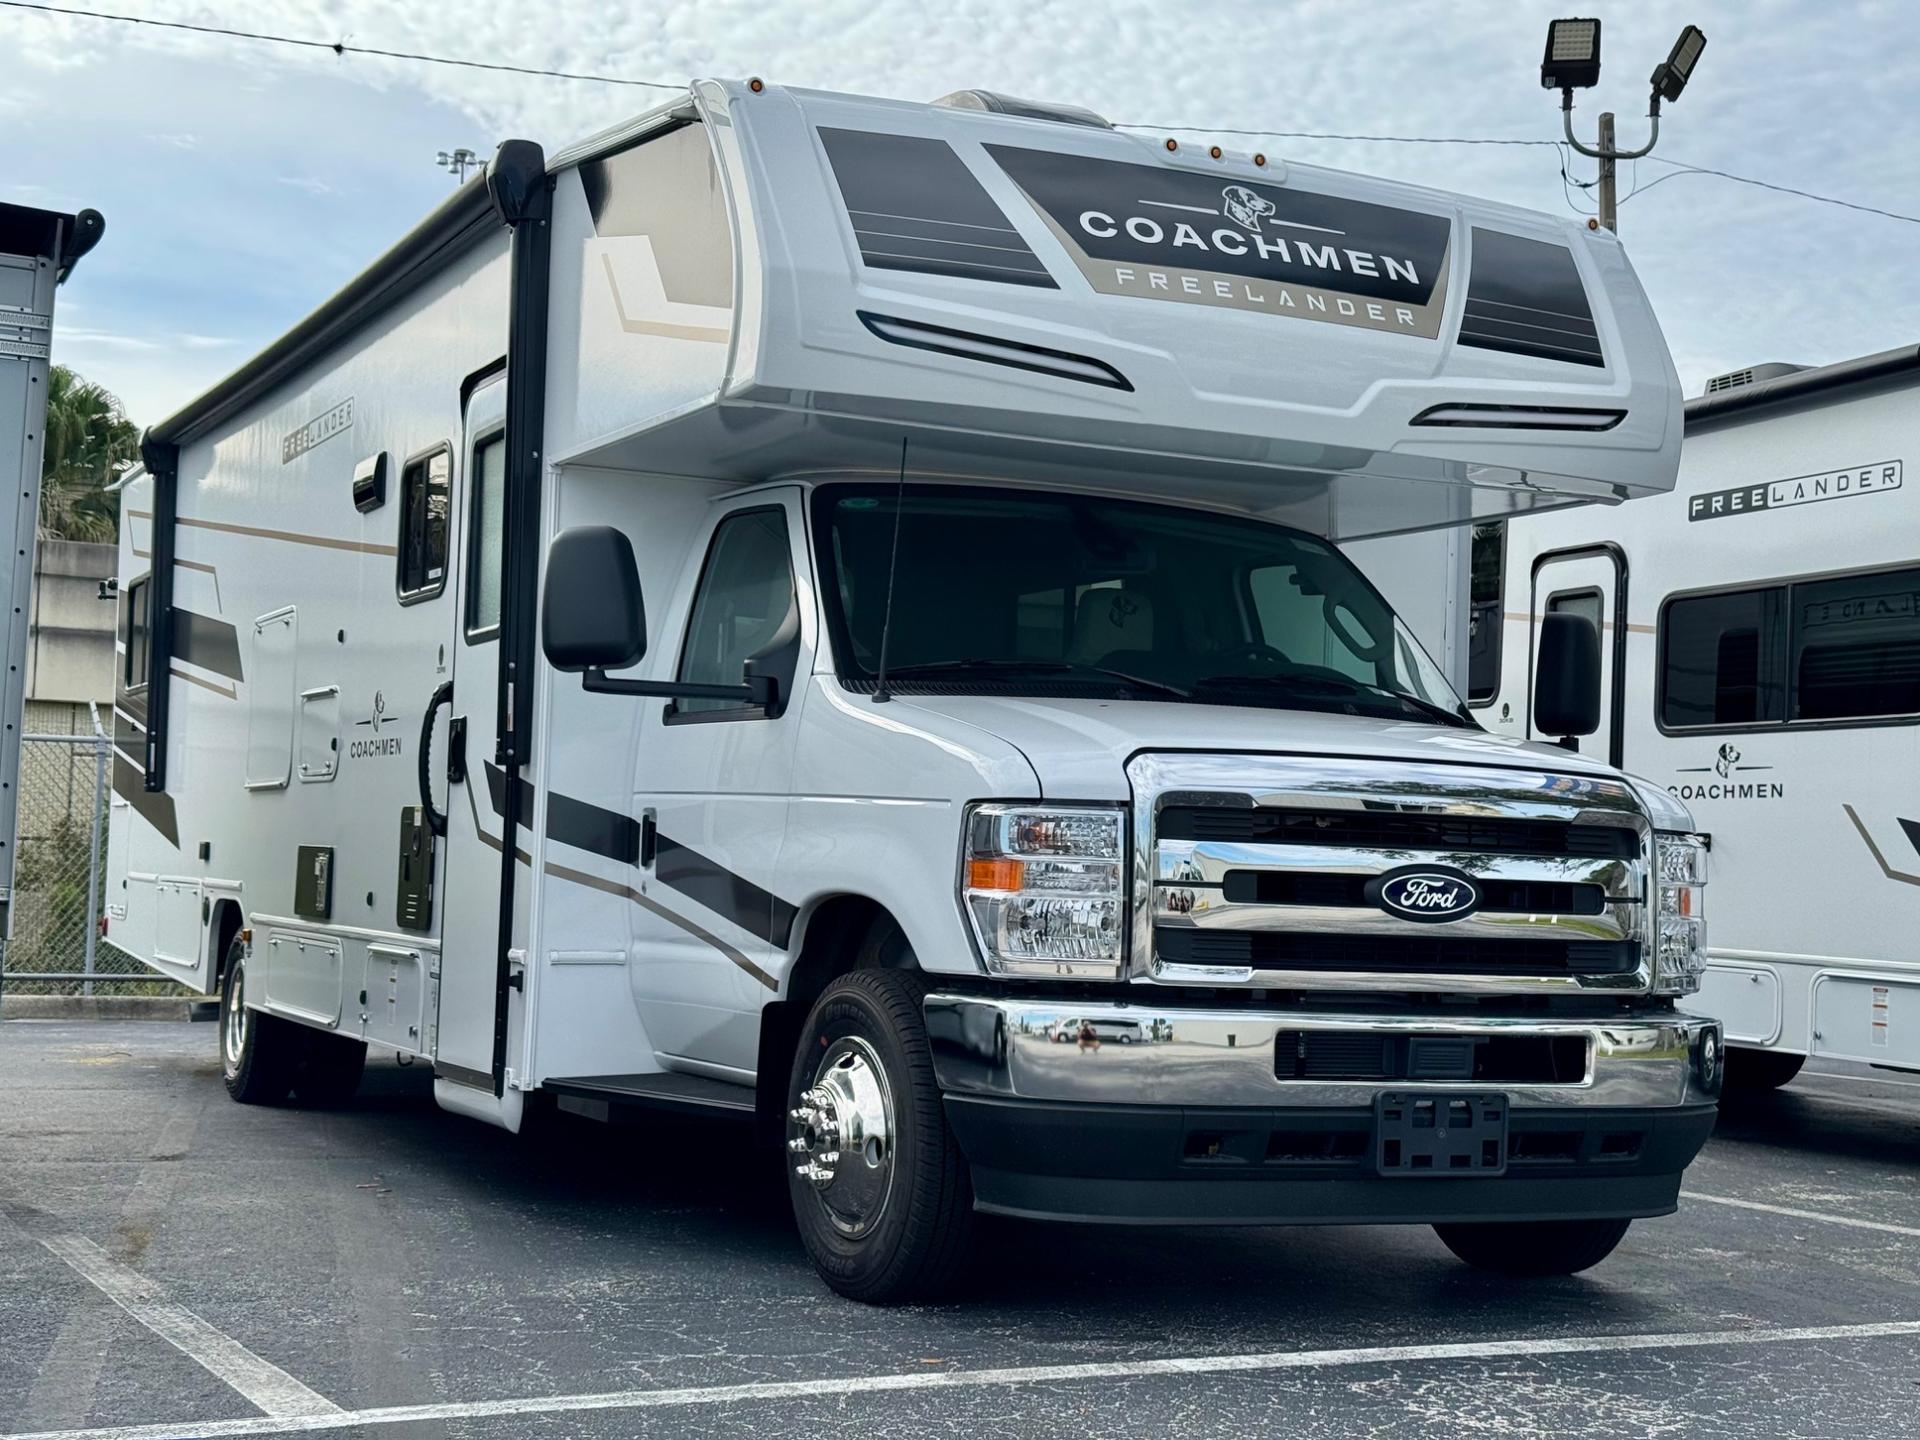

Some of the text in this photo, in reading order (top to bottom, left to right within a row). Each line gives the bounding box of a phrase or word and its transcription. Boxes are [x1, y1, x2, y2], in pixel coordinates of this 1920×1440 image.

[1079, 211, 1421, 285] COACHMEN
[1115, 268, 1416, 326] FREELANDER
[283, 403, 353, 457] FREELANDER
[1692, 466, 1896, 517] FREELANDER
[350, 738, 402, 759] COACHMEN
[1667, 783, 1784, 800] COACHMEN
[1400, 878, 1459, 909] Ford
